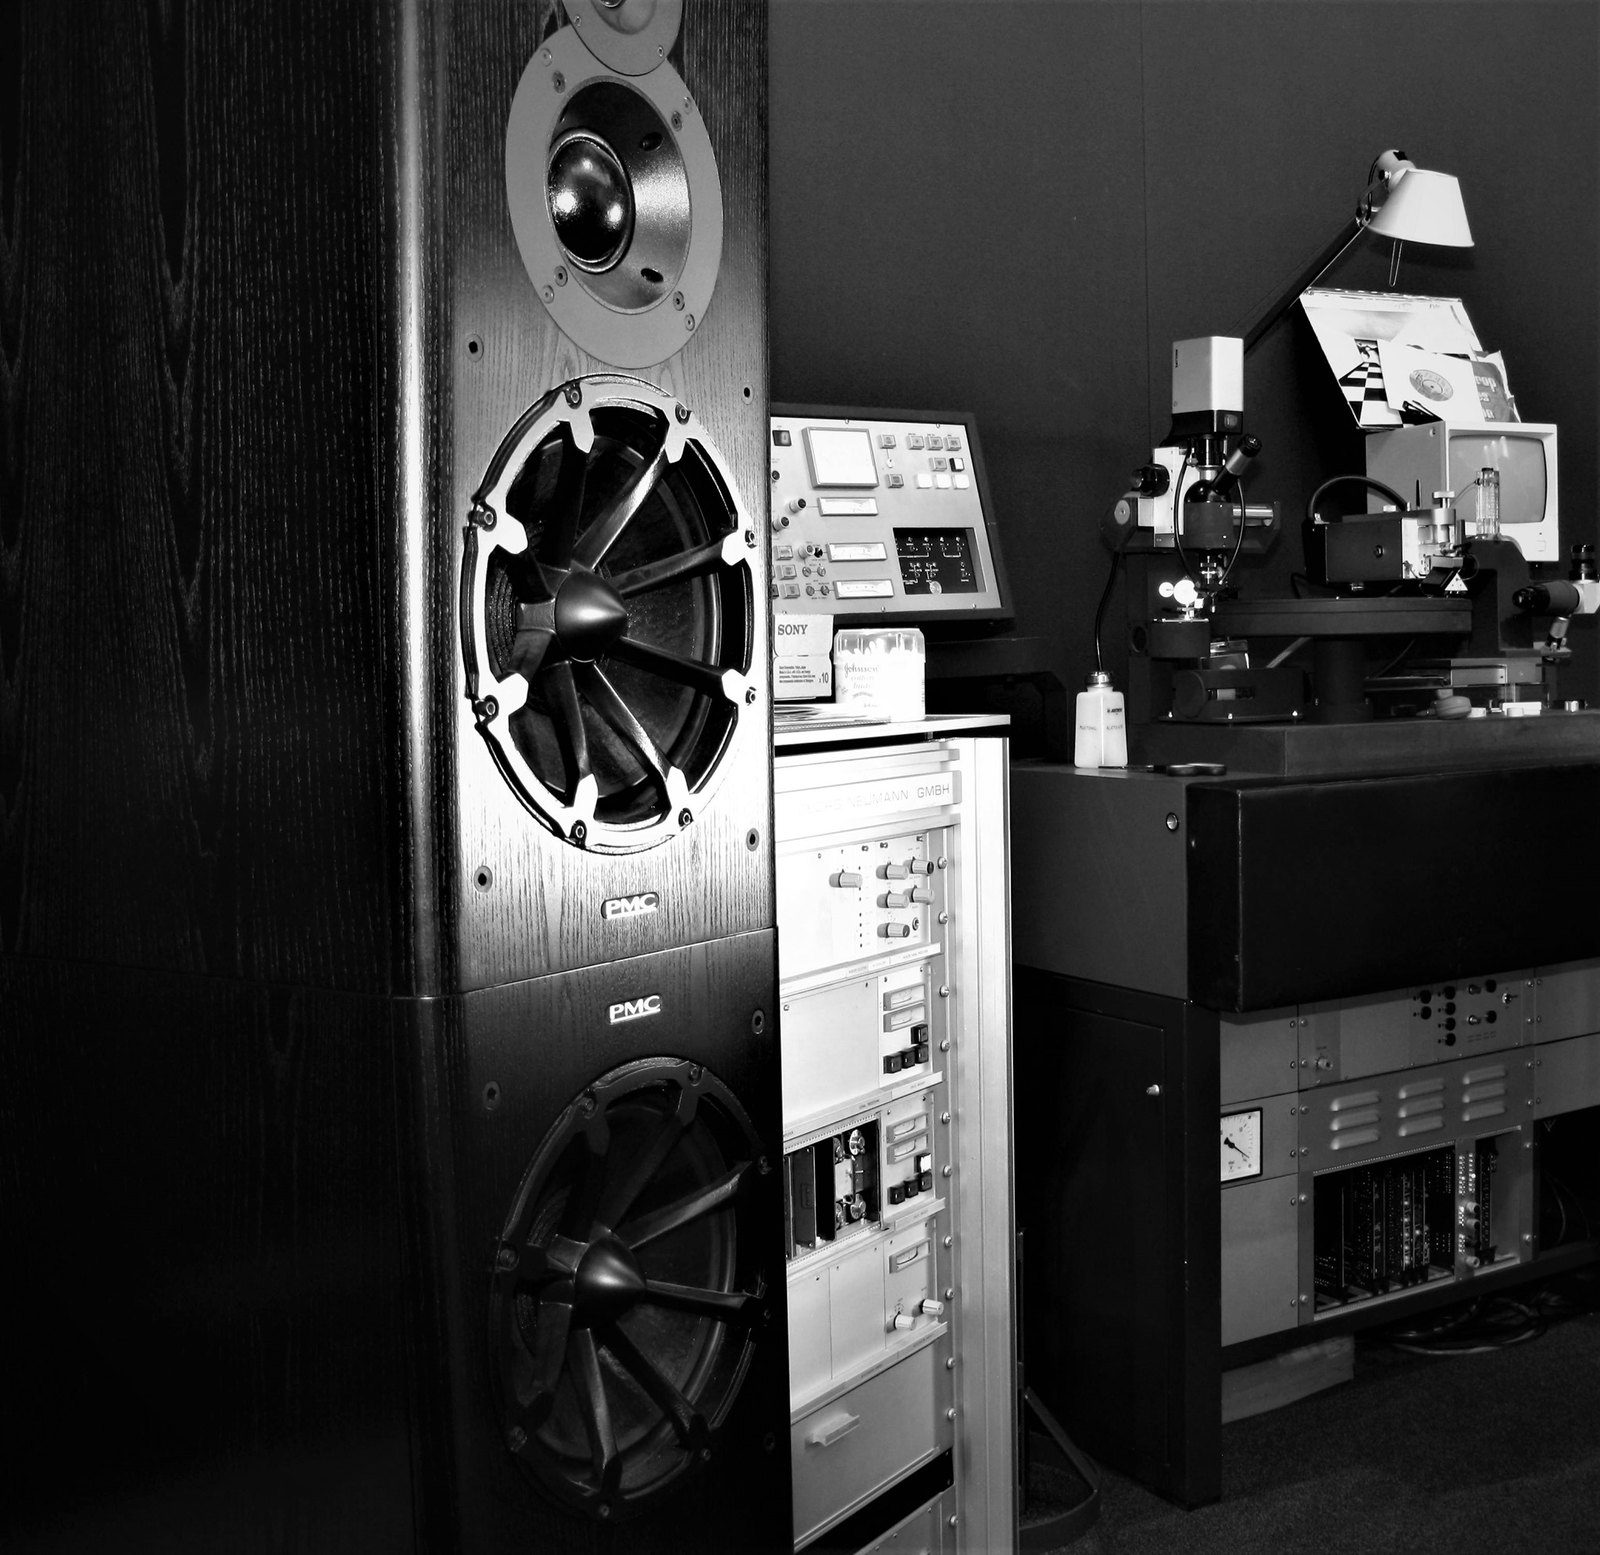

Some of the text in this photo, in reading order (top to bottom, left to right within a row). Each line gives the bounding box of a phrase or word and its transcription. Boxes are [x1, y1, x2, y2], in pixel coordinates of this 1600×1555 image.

[777, 624, 808, 636] SONY
[848, 789, 909, 808] NEUMANN
[917, 783, 950, 799] GMBH
[605, 893, 657, 919] PMC
[609, 995, 661, 1023] PMC
